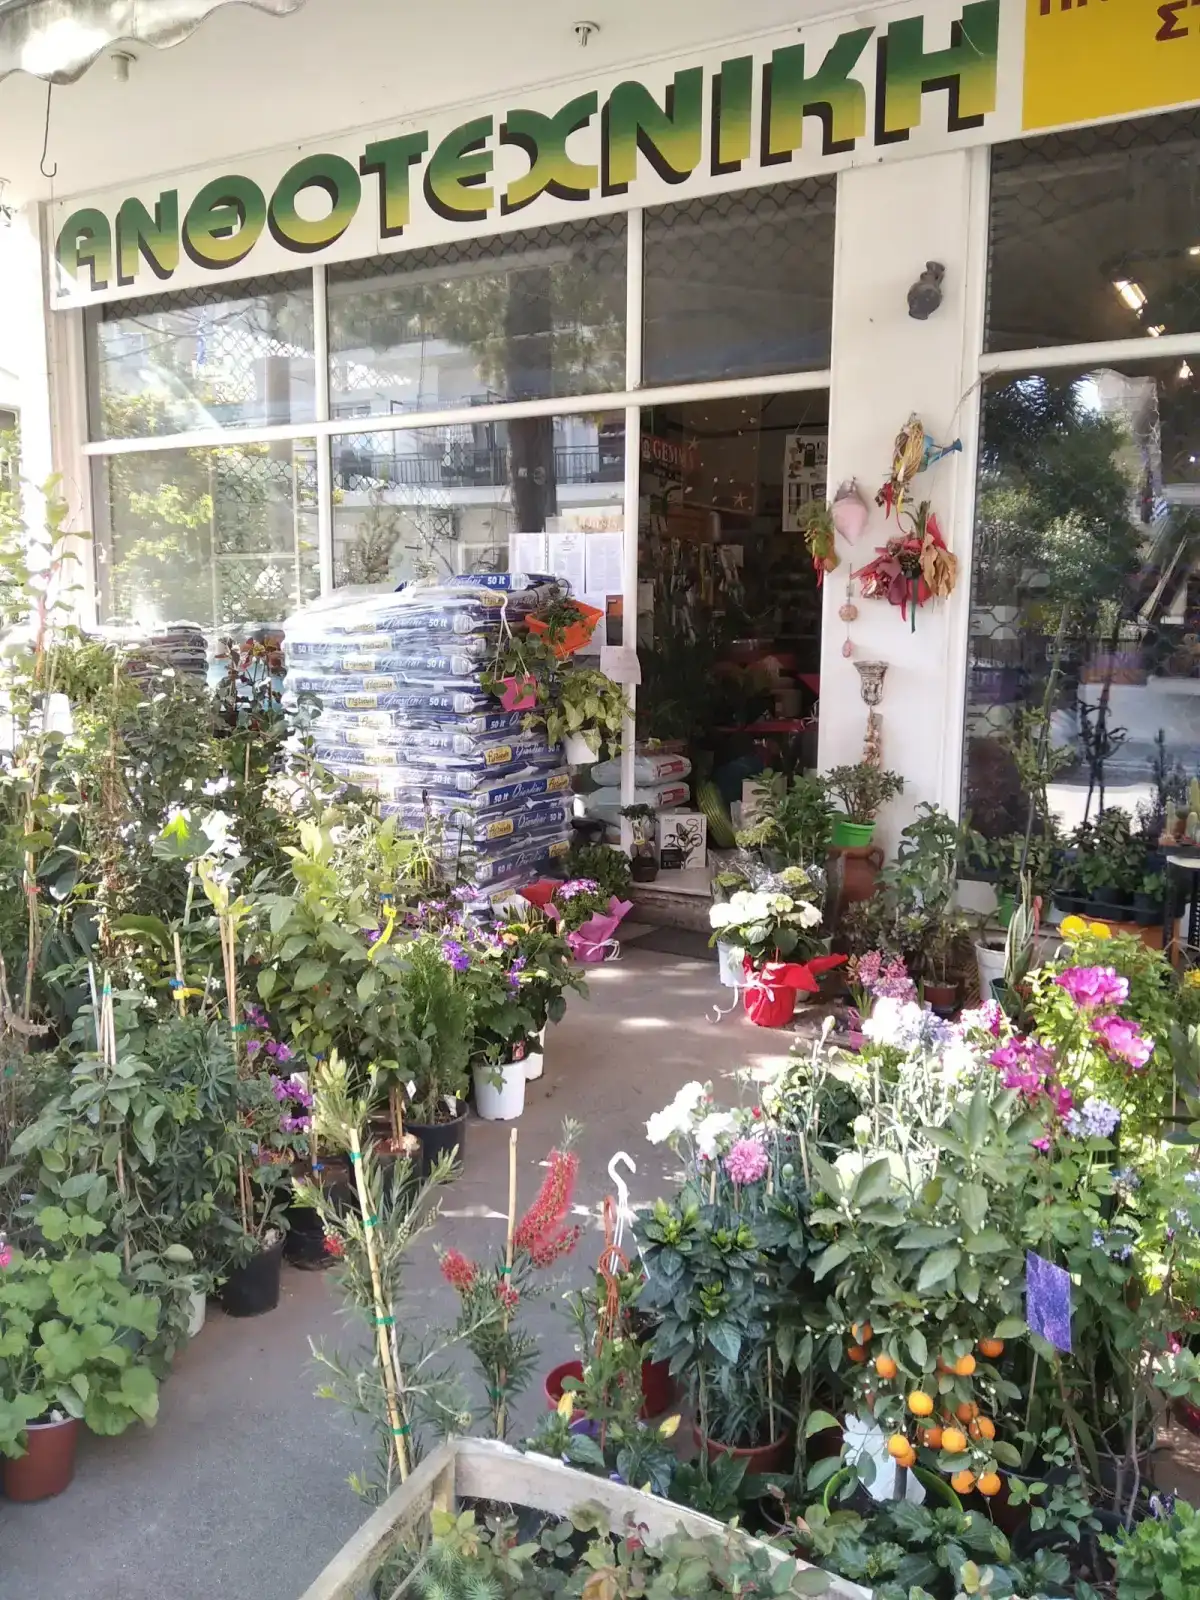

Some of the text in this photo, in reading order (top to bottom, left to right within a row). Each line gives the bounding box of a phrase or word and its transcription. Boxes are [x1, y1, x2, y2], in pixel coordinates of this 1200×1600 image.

[56, 0, 999, 292] ΑΝΘΟΤΕΧΝΙΚΗ
[487, 576, 498, 585] 50
[428, 618, 440, 627] 50
[426, 659, 438, 668] 50
[428, 697, 440, 707] 50
[491, 720, 500, 729] 50
[428, 739, 439, 748] 50
[432, 775, 443, 784] 50
[494, 794, 502, 804] 50
[549, 814, 557, 822] 50
